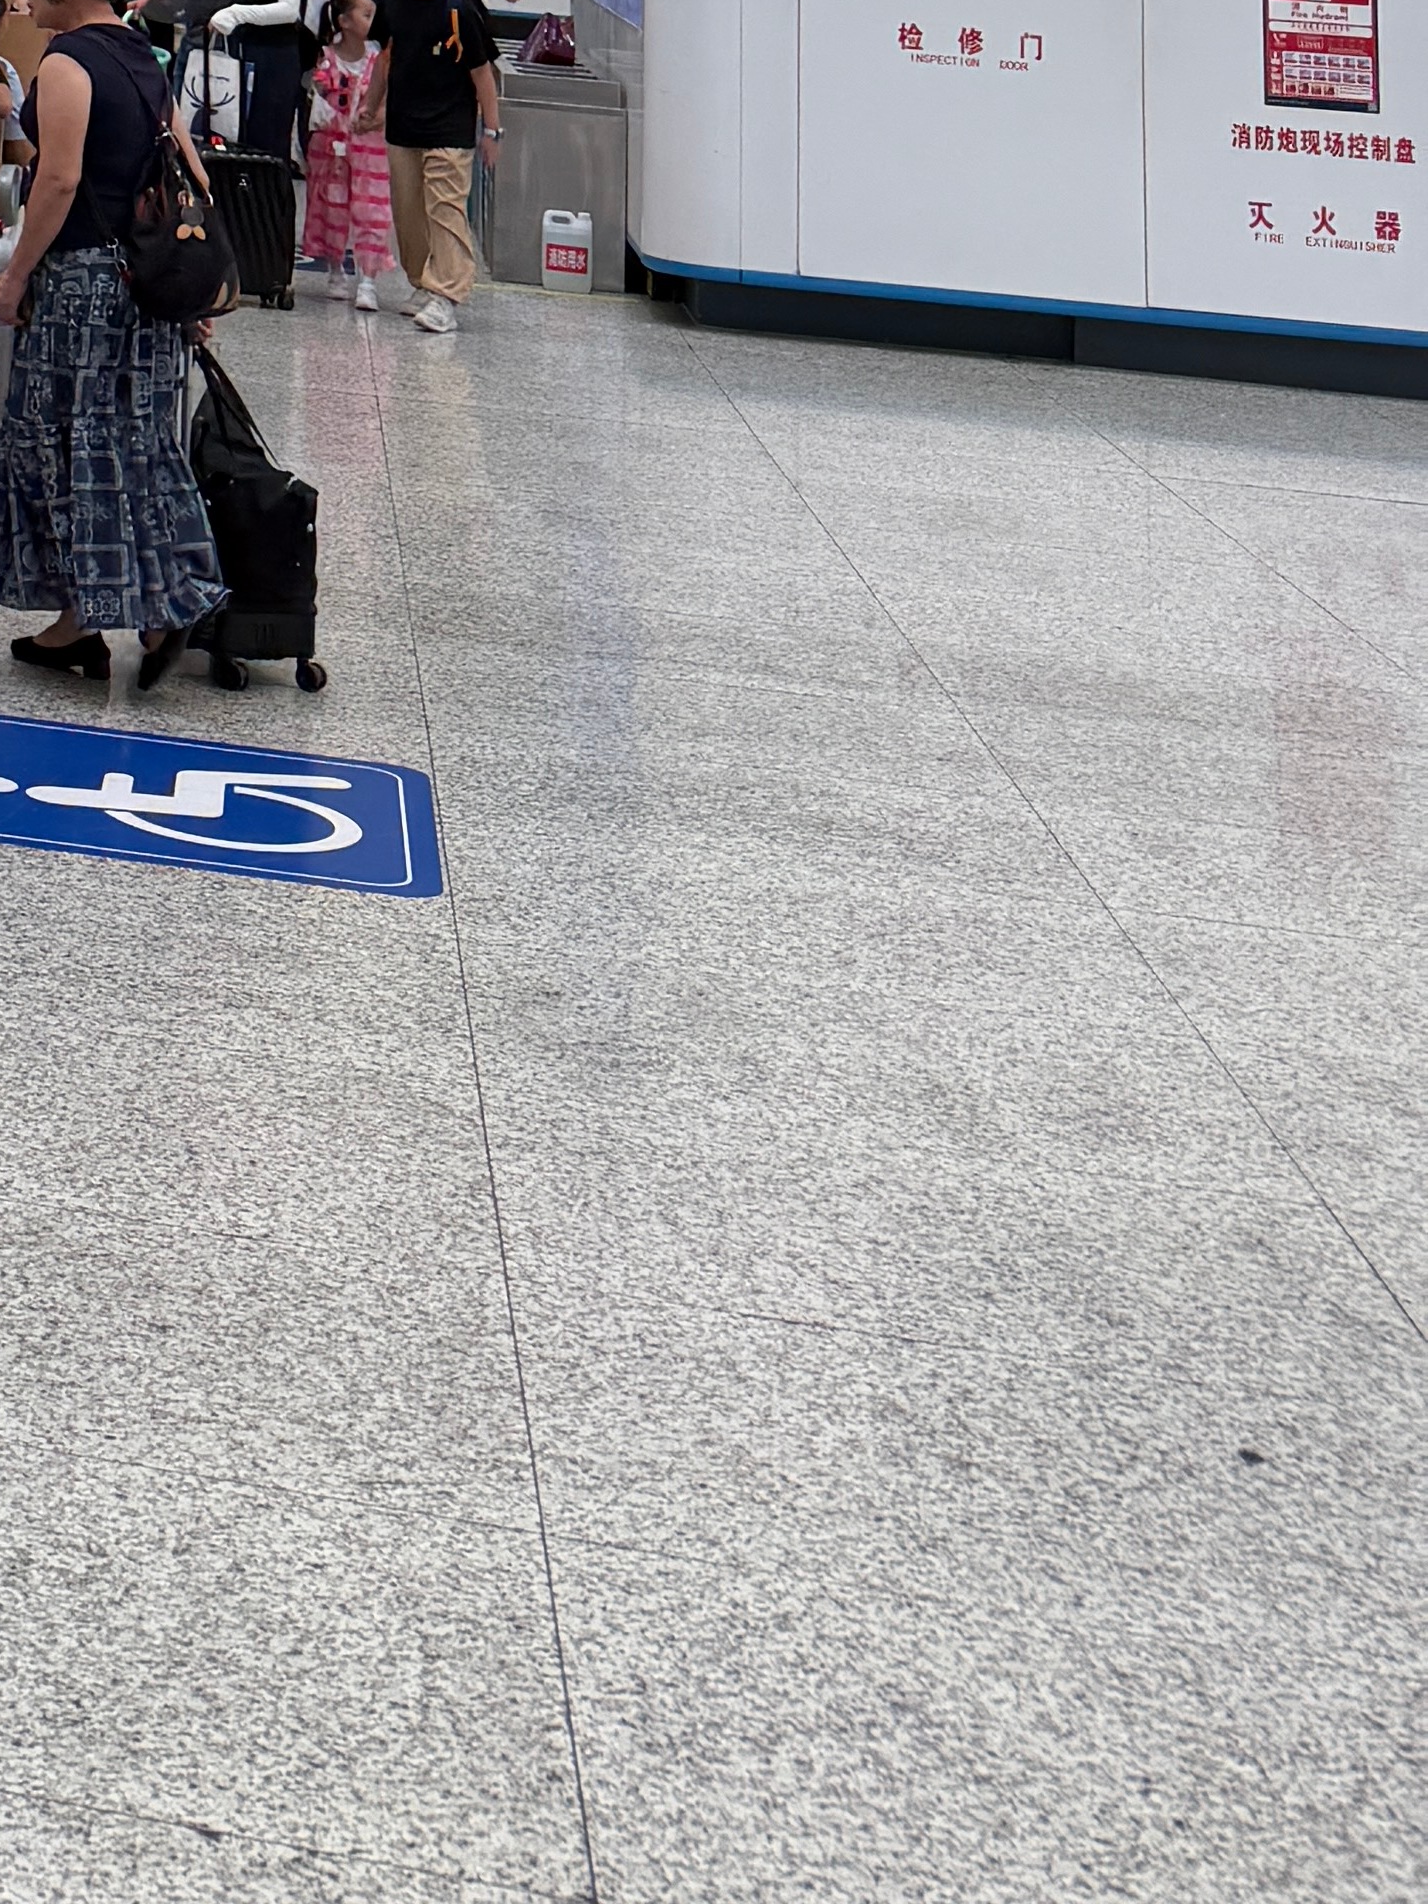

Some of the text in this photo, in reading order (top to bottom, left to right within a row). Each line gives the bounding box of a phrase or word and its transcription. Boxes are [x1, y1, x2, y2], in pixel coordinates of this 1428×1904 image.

[898, 23, 1043, 62] 检修门
[910, 54, 980, 68] INSPECTION
[1231, 123, 1416, 164] 消防炮现场控制盘
[1248, 201, 1402, 242] 灭火器
[1254, 233, 1397, 254] FIRE EXTINGUISHER
